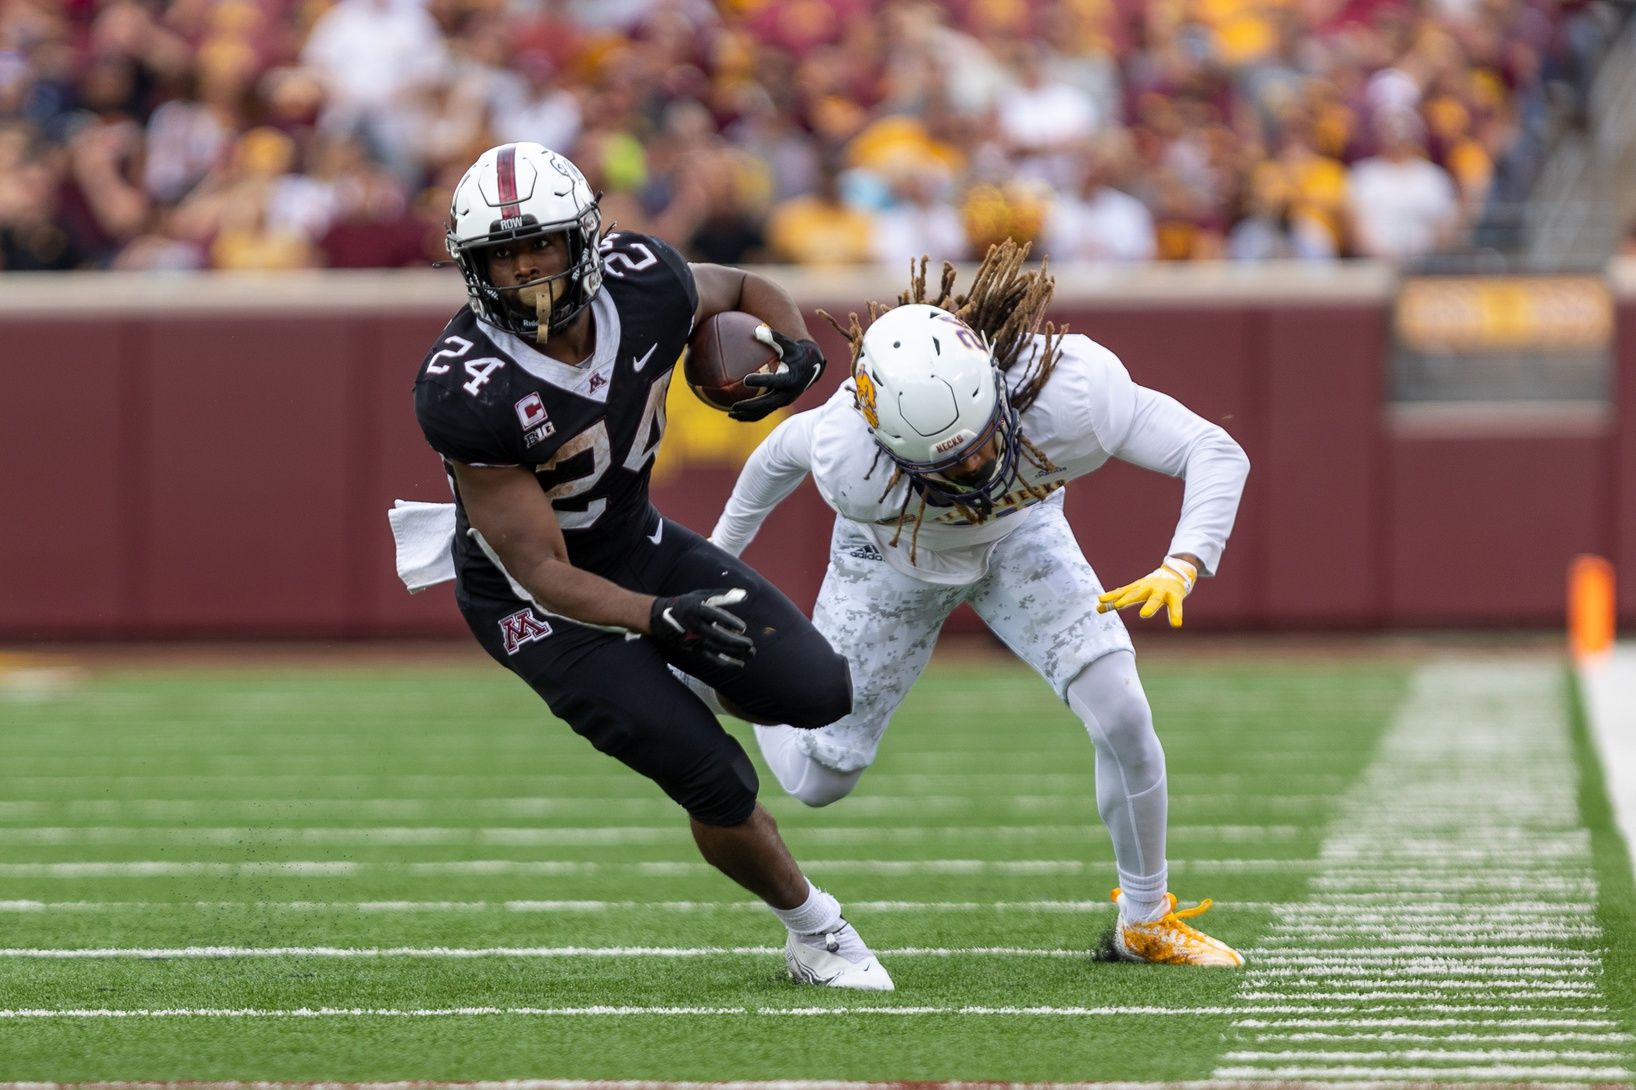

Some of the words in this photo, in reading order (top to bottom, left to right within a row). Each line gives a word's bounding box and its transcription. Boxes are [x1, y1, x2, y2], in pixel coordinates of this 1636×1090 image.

[500, 217, 523, 230] ROW
[426, 335, 505, 396] 24
[517, 394, 545, 428] C
[535, 368, 673, 531] 24
[498, 607, 554, 656] M
